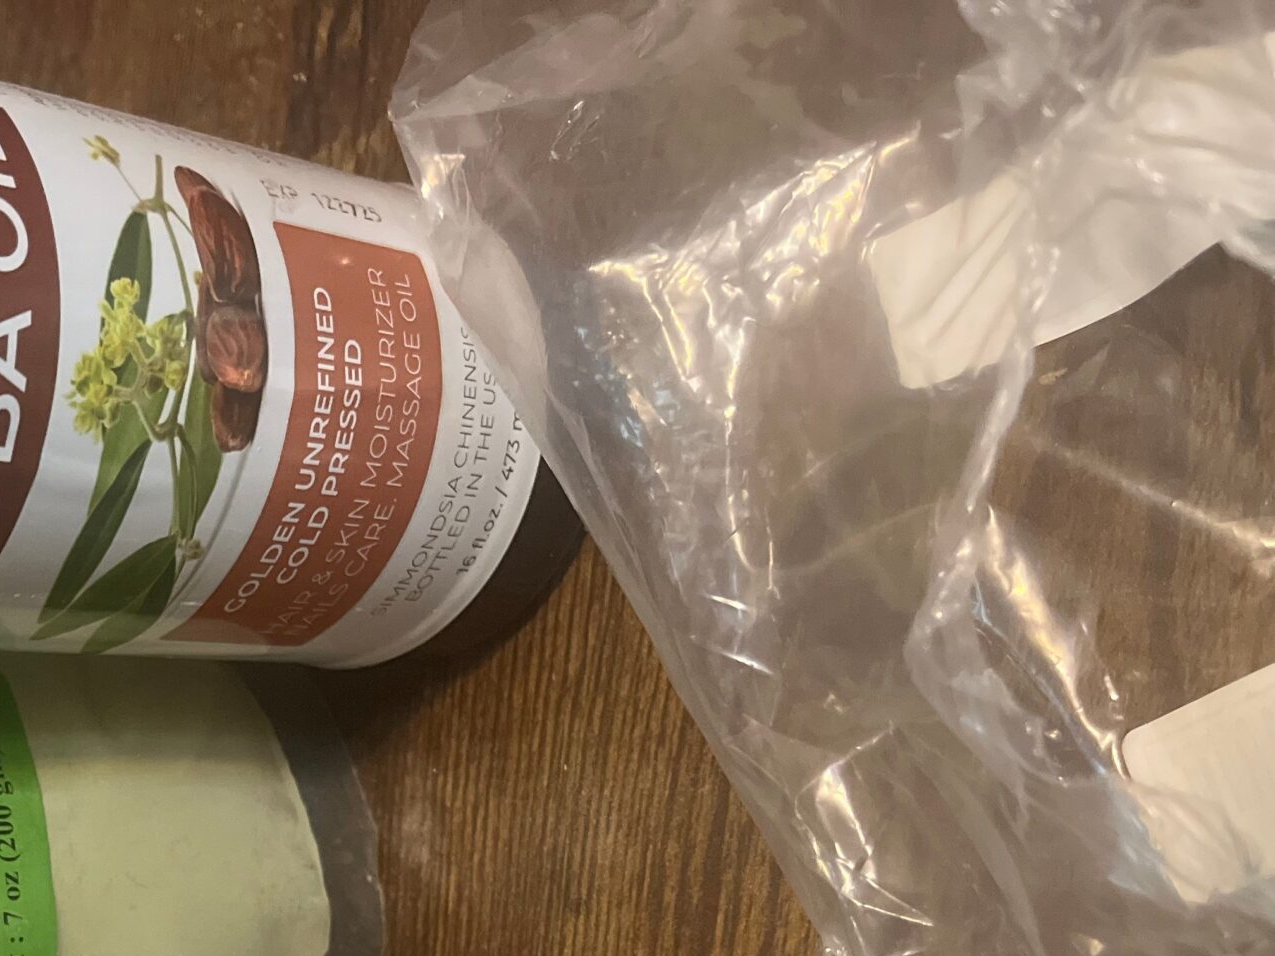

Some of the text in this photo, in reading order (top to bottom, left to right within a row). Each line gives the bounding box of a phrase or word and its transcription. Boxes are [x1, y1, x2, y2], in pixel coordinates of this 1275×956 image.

[393, 273, 417, 321] OIL
[225, 286, 333, 613] GOLDEN UNREFINED
[267, 267, 384, 635] HAIR & SKIN MOISTURIZER
[276, 339, 362, 584] COLD PRESSED
[387, 337, 421, 487] MASSAGE
[370, 477, 460, 617] SIMMONDSIA
[405, 504, 470, 602] BOTTLED
[464, 471, 482, 498] IN
[473, 406, 494, 463] THE
[456, 555, 477, 576] 16
[500, 438, 522, 480] 473
[285, 583, 347, 637] NAILS
[4, 911, 24, 927] 7
[6, 869, 24, 899] oz
